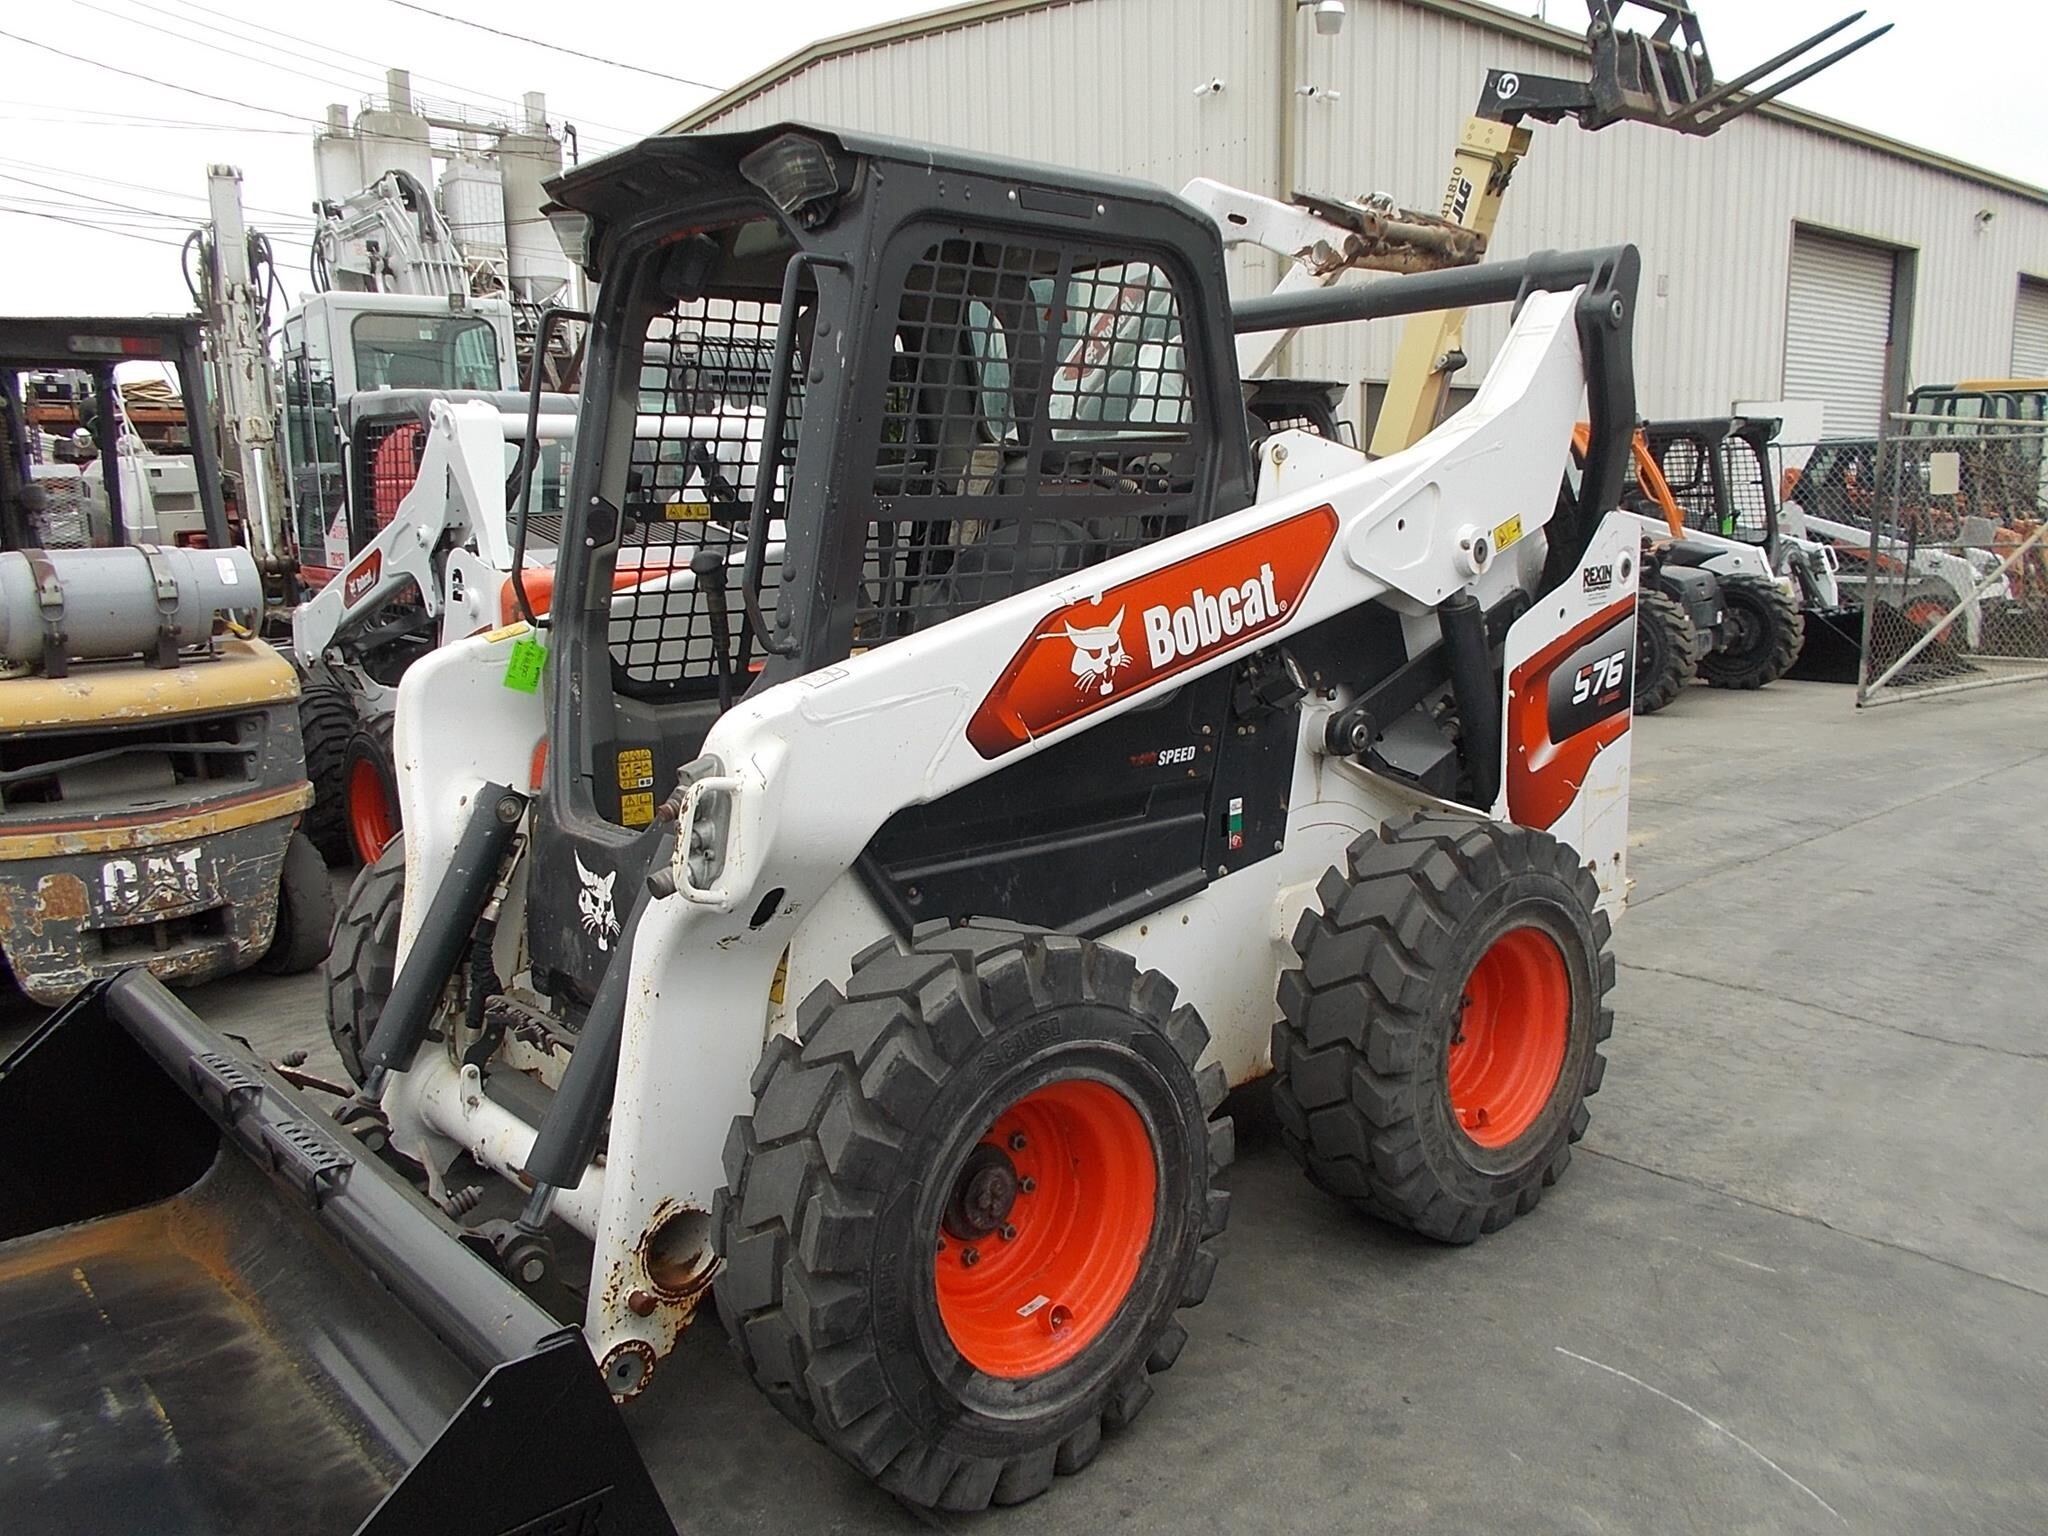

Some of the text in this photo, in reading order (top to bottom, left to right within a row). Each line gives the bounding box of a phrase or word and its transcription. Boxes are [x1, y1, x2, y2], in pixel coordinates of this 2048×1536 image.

[1499, 77, 1517, 95] 5
[1441, 166, 1463, 218] 411810
[1451, 178, 1473, 225] JLG
[1583, 565, 1612, 587] REXIN
[1143, 562, 1280, 669] Bobcat
[1572, 650, 1626, 705] S76
[1157, 746, 1196, 766] SPEED
[103, 847, 202, 911] CAT
